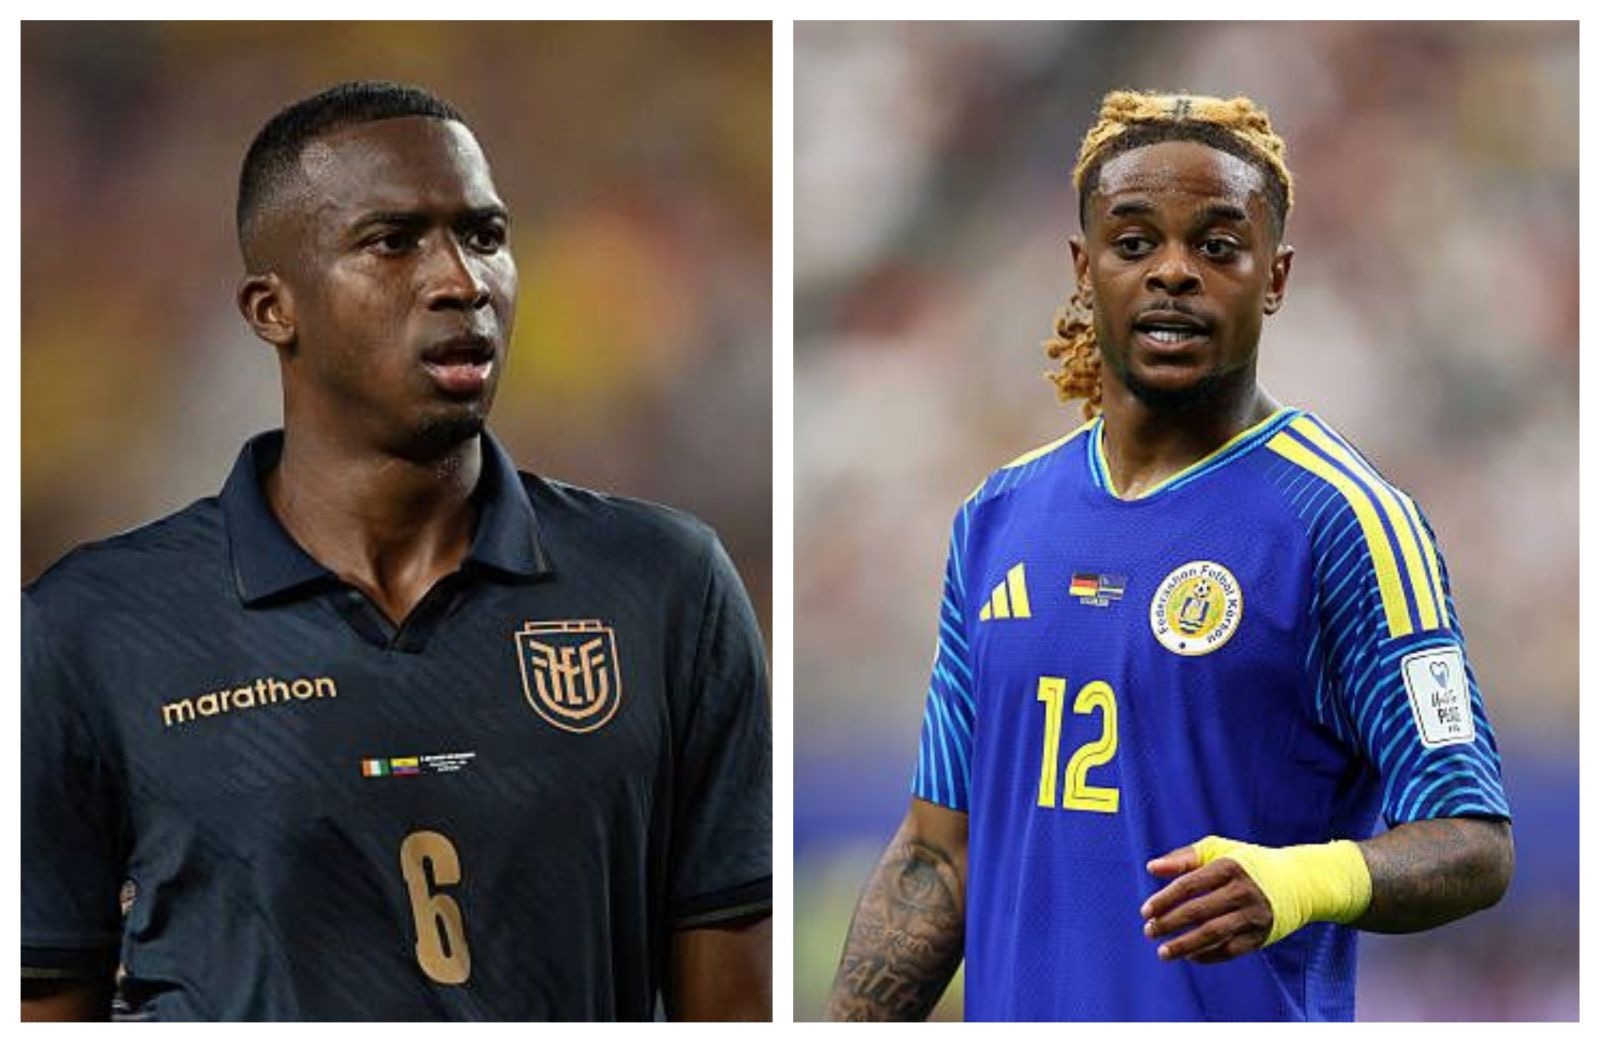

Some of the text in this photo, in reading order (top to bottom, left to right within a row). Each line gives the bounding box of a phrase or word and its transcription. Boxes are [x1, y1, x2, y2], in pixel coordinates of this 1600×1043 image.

[161, 675, 338, 727] marathon
[1037, 676, 1120, 813] 12
[400, 830, 471, 985] 6
